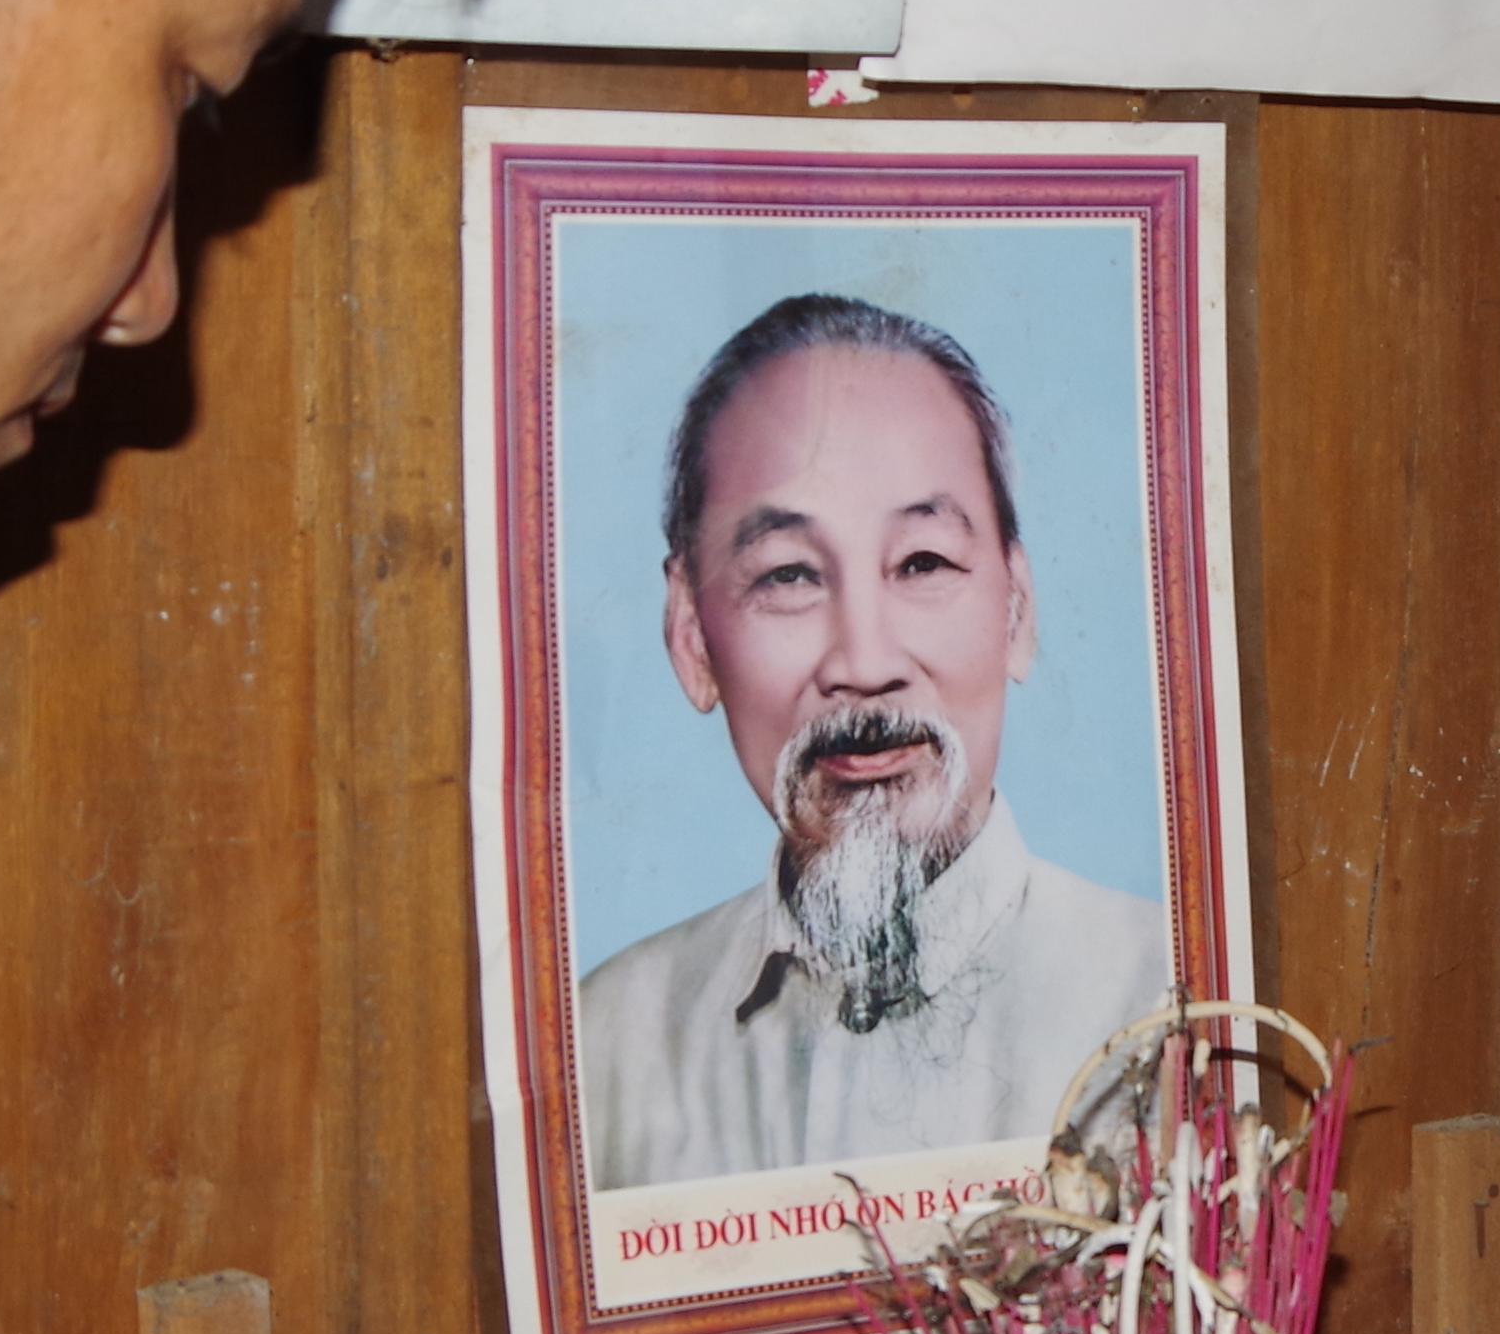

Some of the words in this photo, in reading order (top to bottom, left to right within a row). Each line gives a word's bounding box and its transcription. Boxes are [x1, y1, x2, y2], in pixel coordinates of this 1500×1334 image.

[618, 1219, 682, 1261] ĐỜI
[693, 1208, 758, 1250] ĐỜI
[769, 1194, 847, 1240] NHỚ
